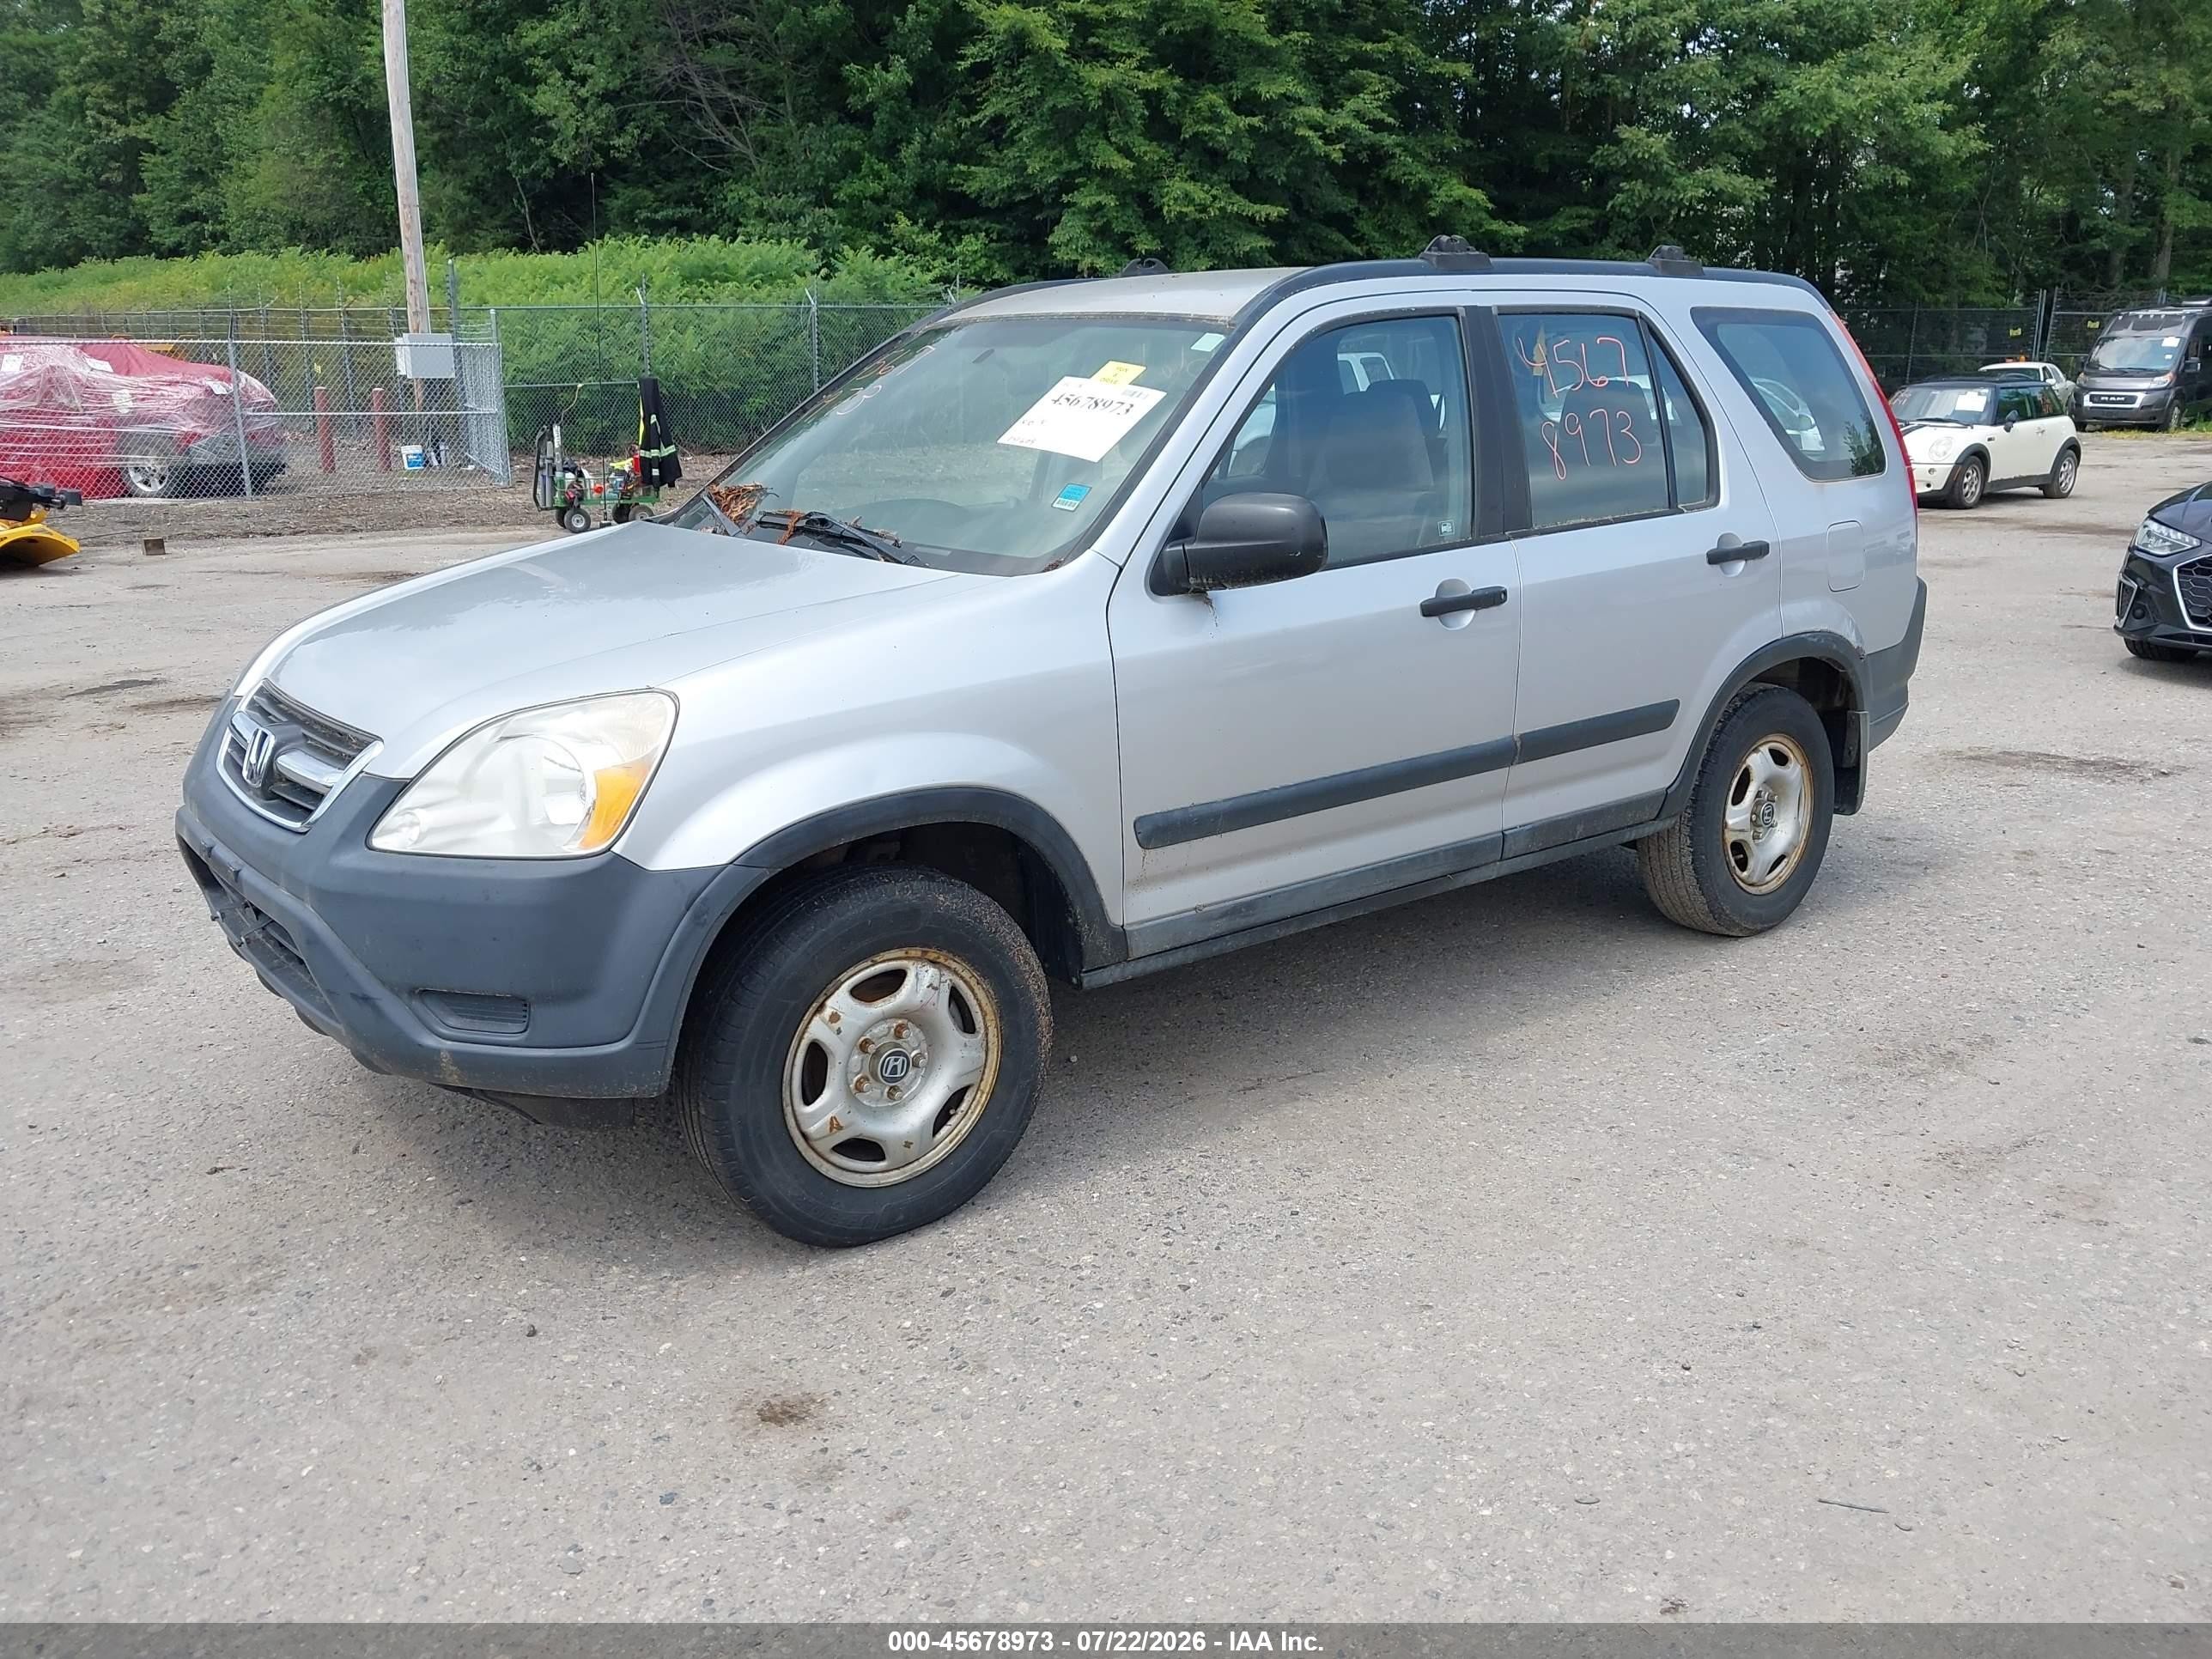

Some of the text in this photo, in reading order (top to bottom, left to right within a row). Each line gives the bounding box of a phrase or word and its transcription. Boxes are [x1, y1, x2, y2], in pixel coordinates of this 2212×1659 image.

[1517, 336, 1630, 398] 4567
[1051, 392, 1134, 416] 45678973
[1540, 408, 1642, 480] 8973
